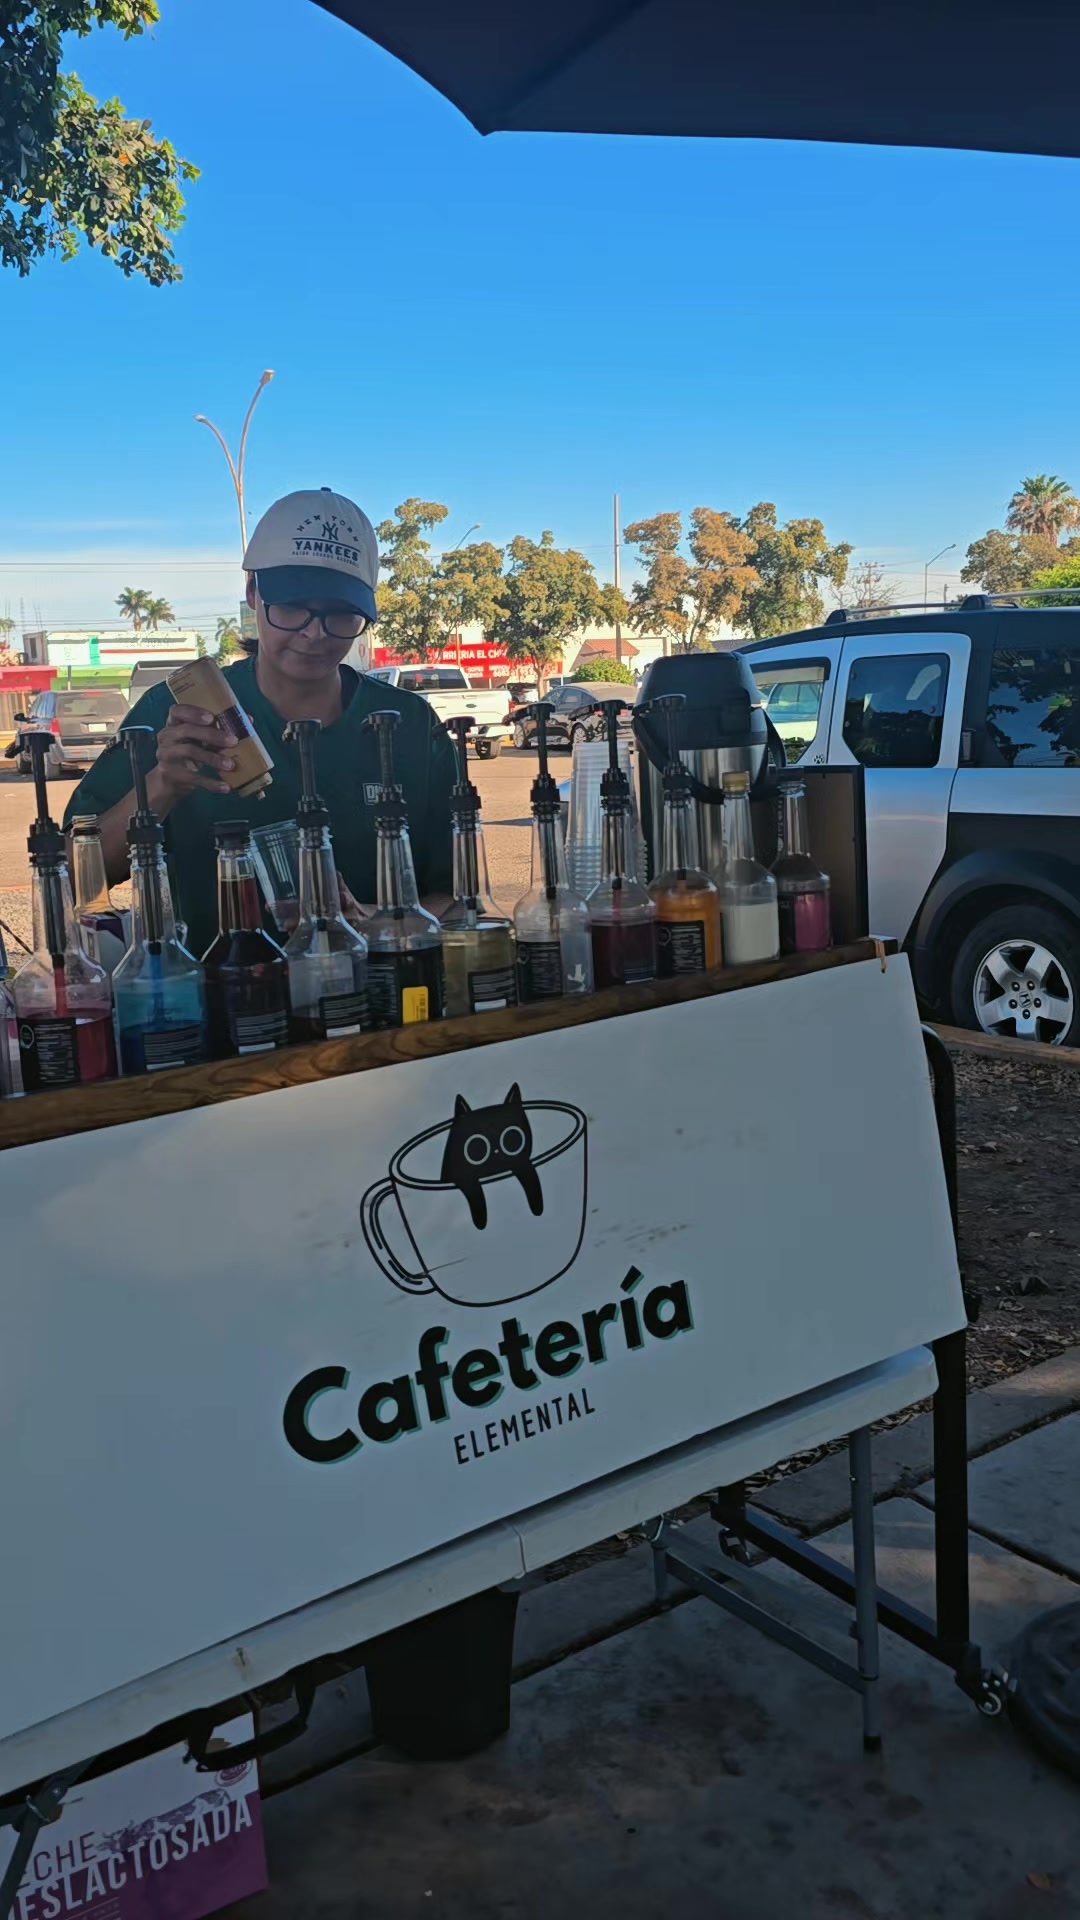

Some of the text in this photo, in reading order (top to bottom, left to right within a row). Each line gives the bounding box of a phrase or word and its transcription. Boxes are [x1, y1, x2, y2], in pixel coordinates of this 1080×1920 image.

[295, 541, 359, 561] YANKEES
[332, 516, 358, 542] YORK
[476, 650, 486, 659] EL
[282, 1265, 694, 1464] Cafetería
[453, 1388, 596, 1465] ELEMENTAL
[8, 1796, 253, 1920] ESLACTOSADA
